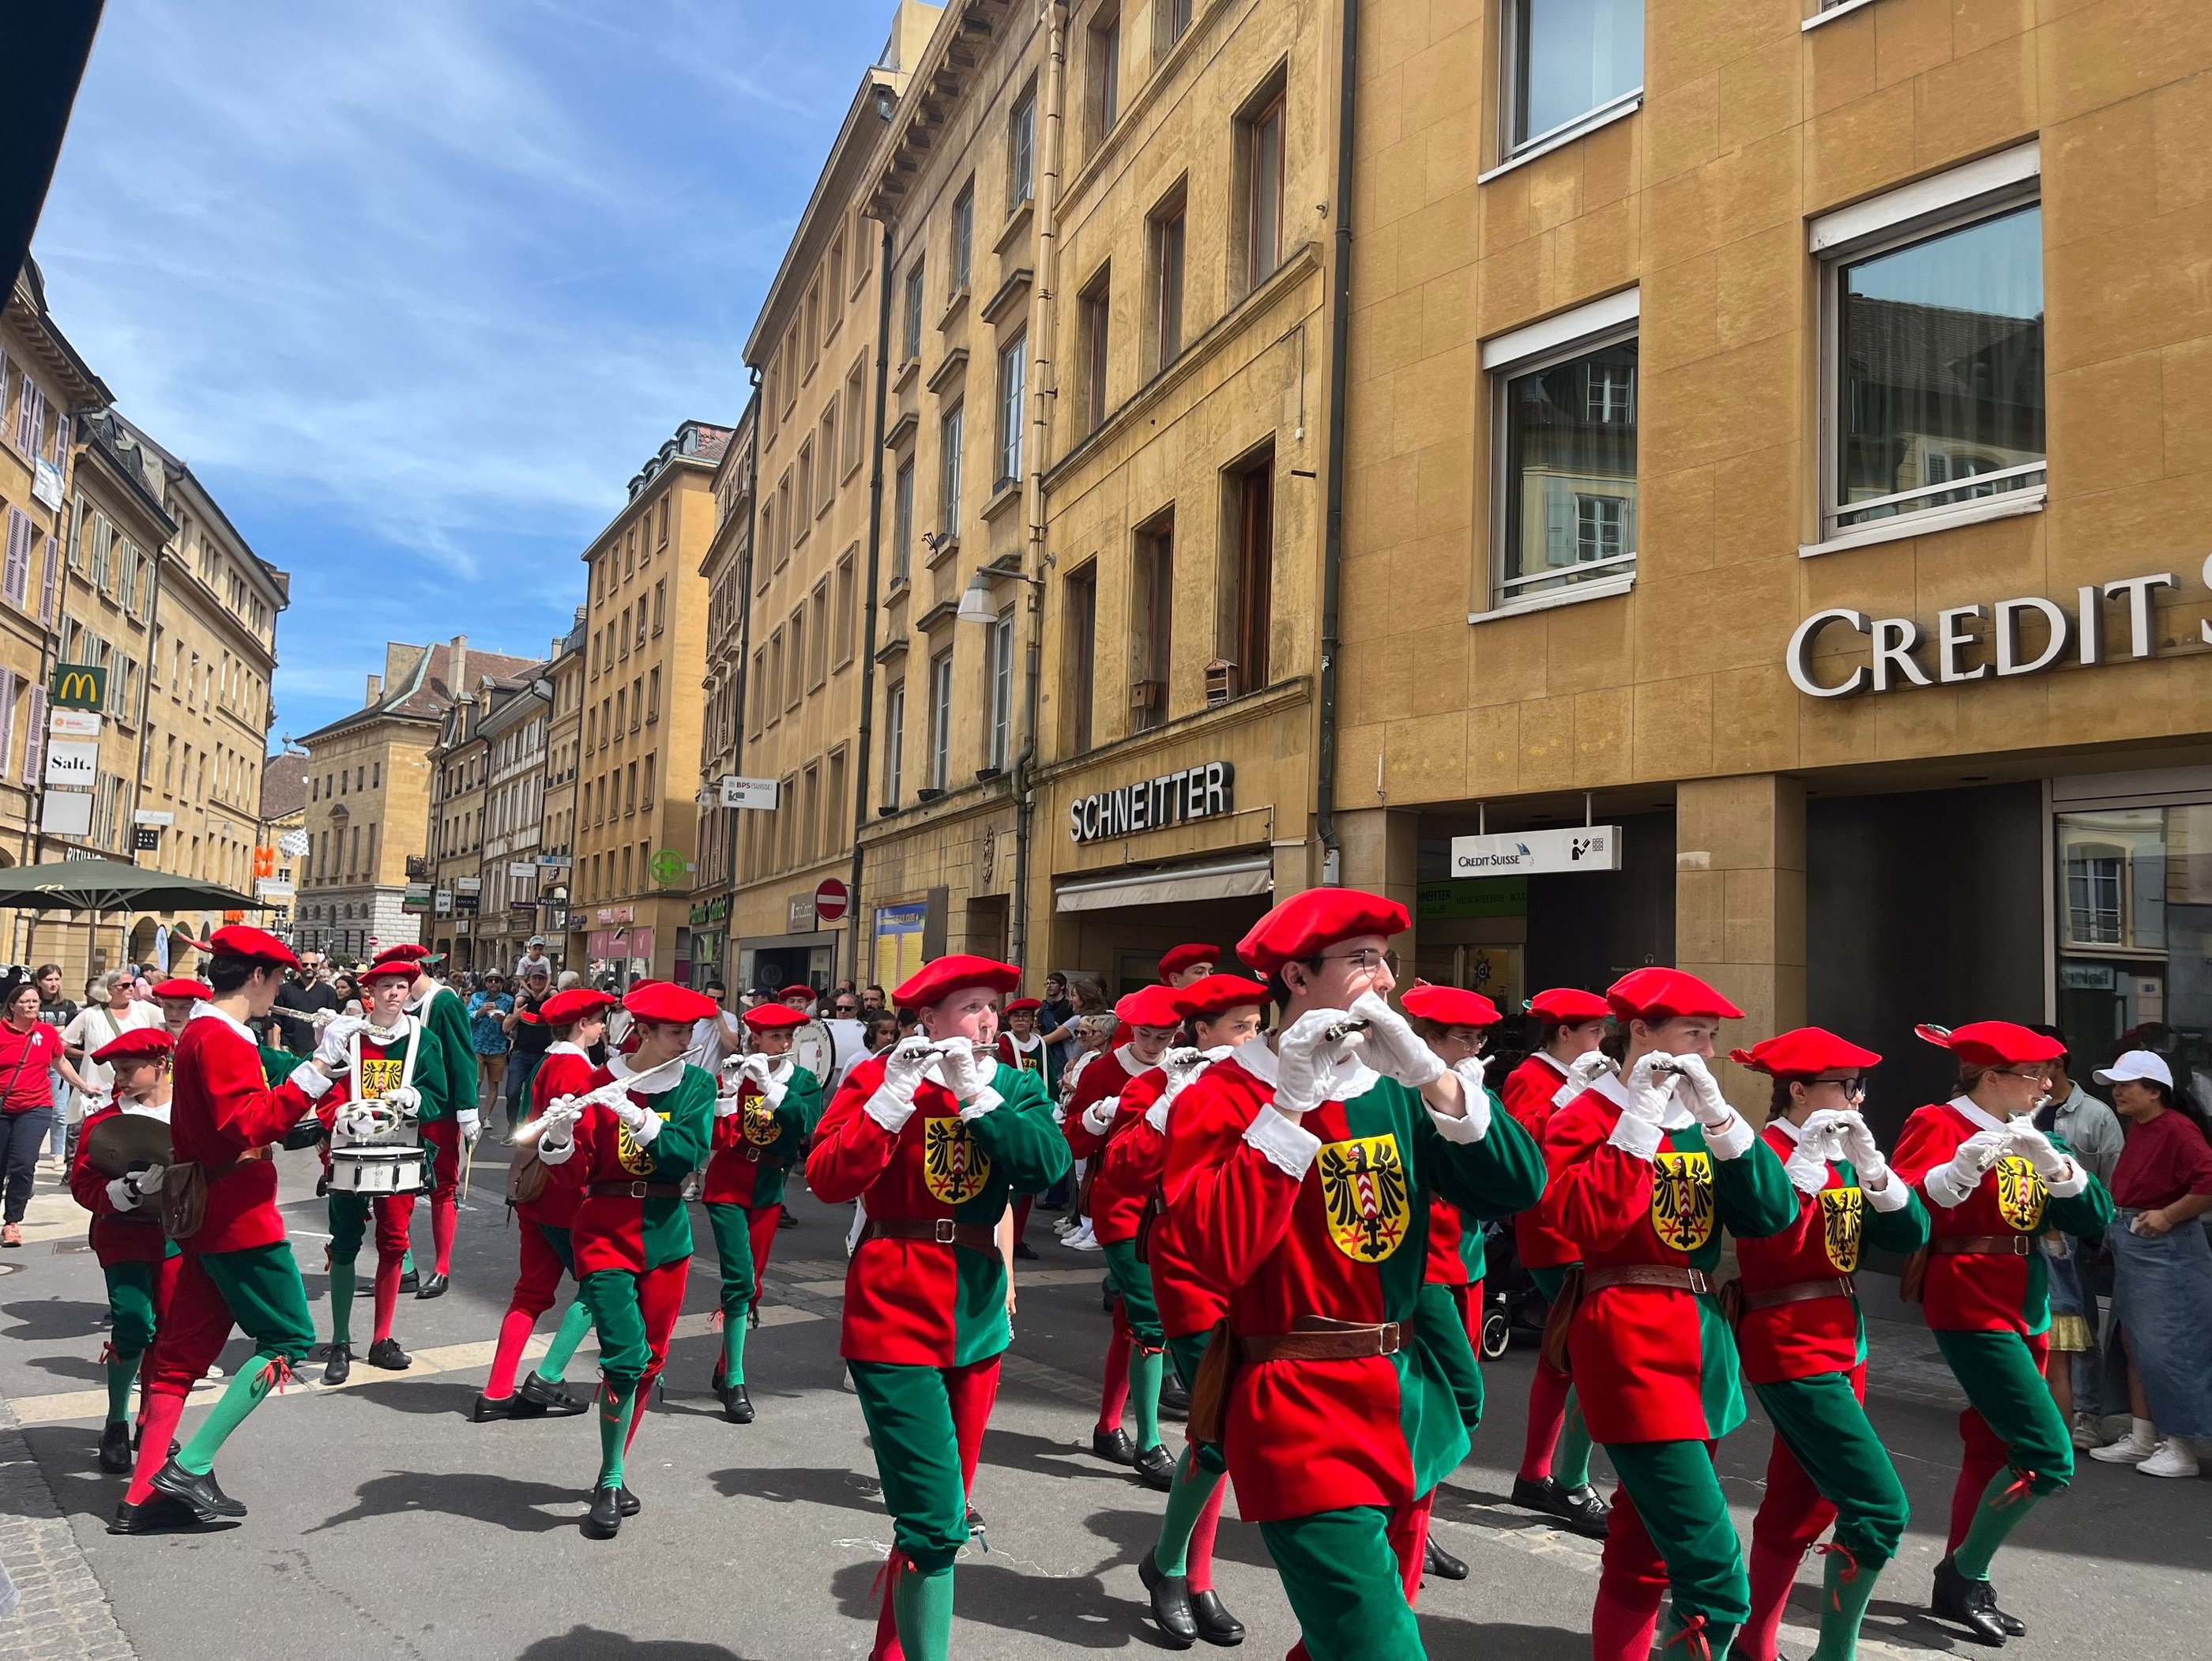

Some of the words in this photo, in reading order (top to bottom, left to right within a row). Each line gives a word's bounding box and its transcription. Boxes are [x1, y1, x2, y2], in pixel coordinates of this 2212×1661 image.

[1786, 572, 2176, 698] CREDIT
[51, 755, 92, 770] Salt.
[1069, 761, 1229, 843] SCHNEITTER
[1458, 856, 1490, 868] CREDIT
[1491, 854, 1520, 866] SUISSE
